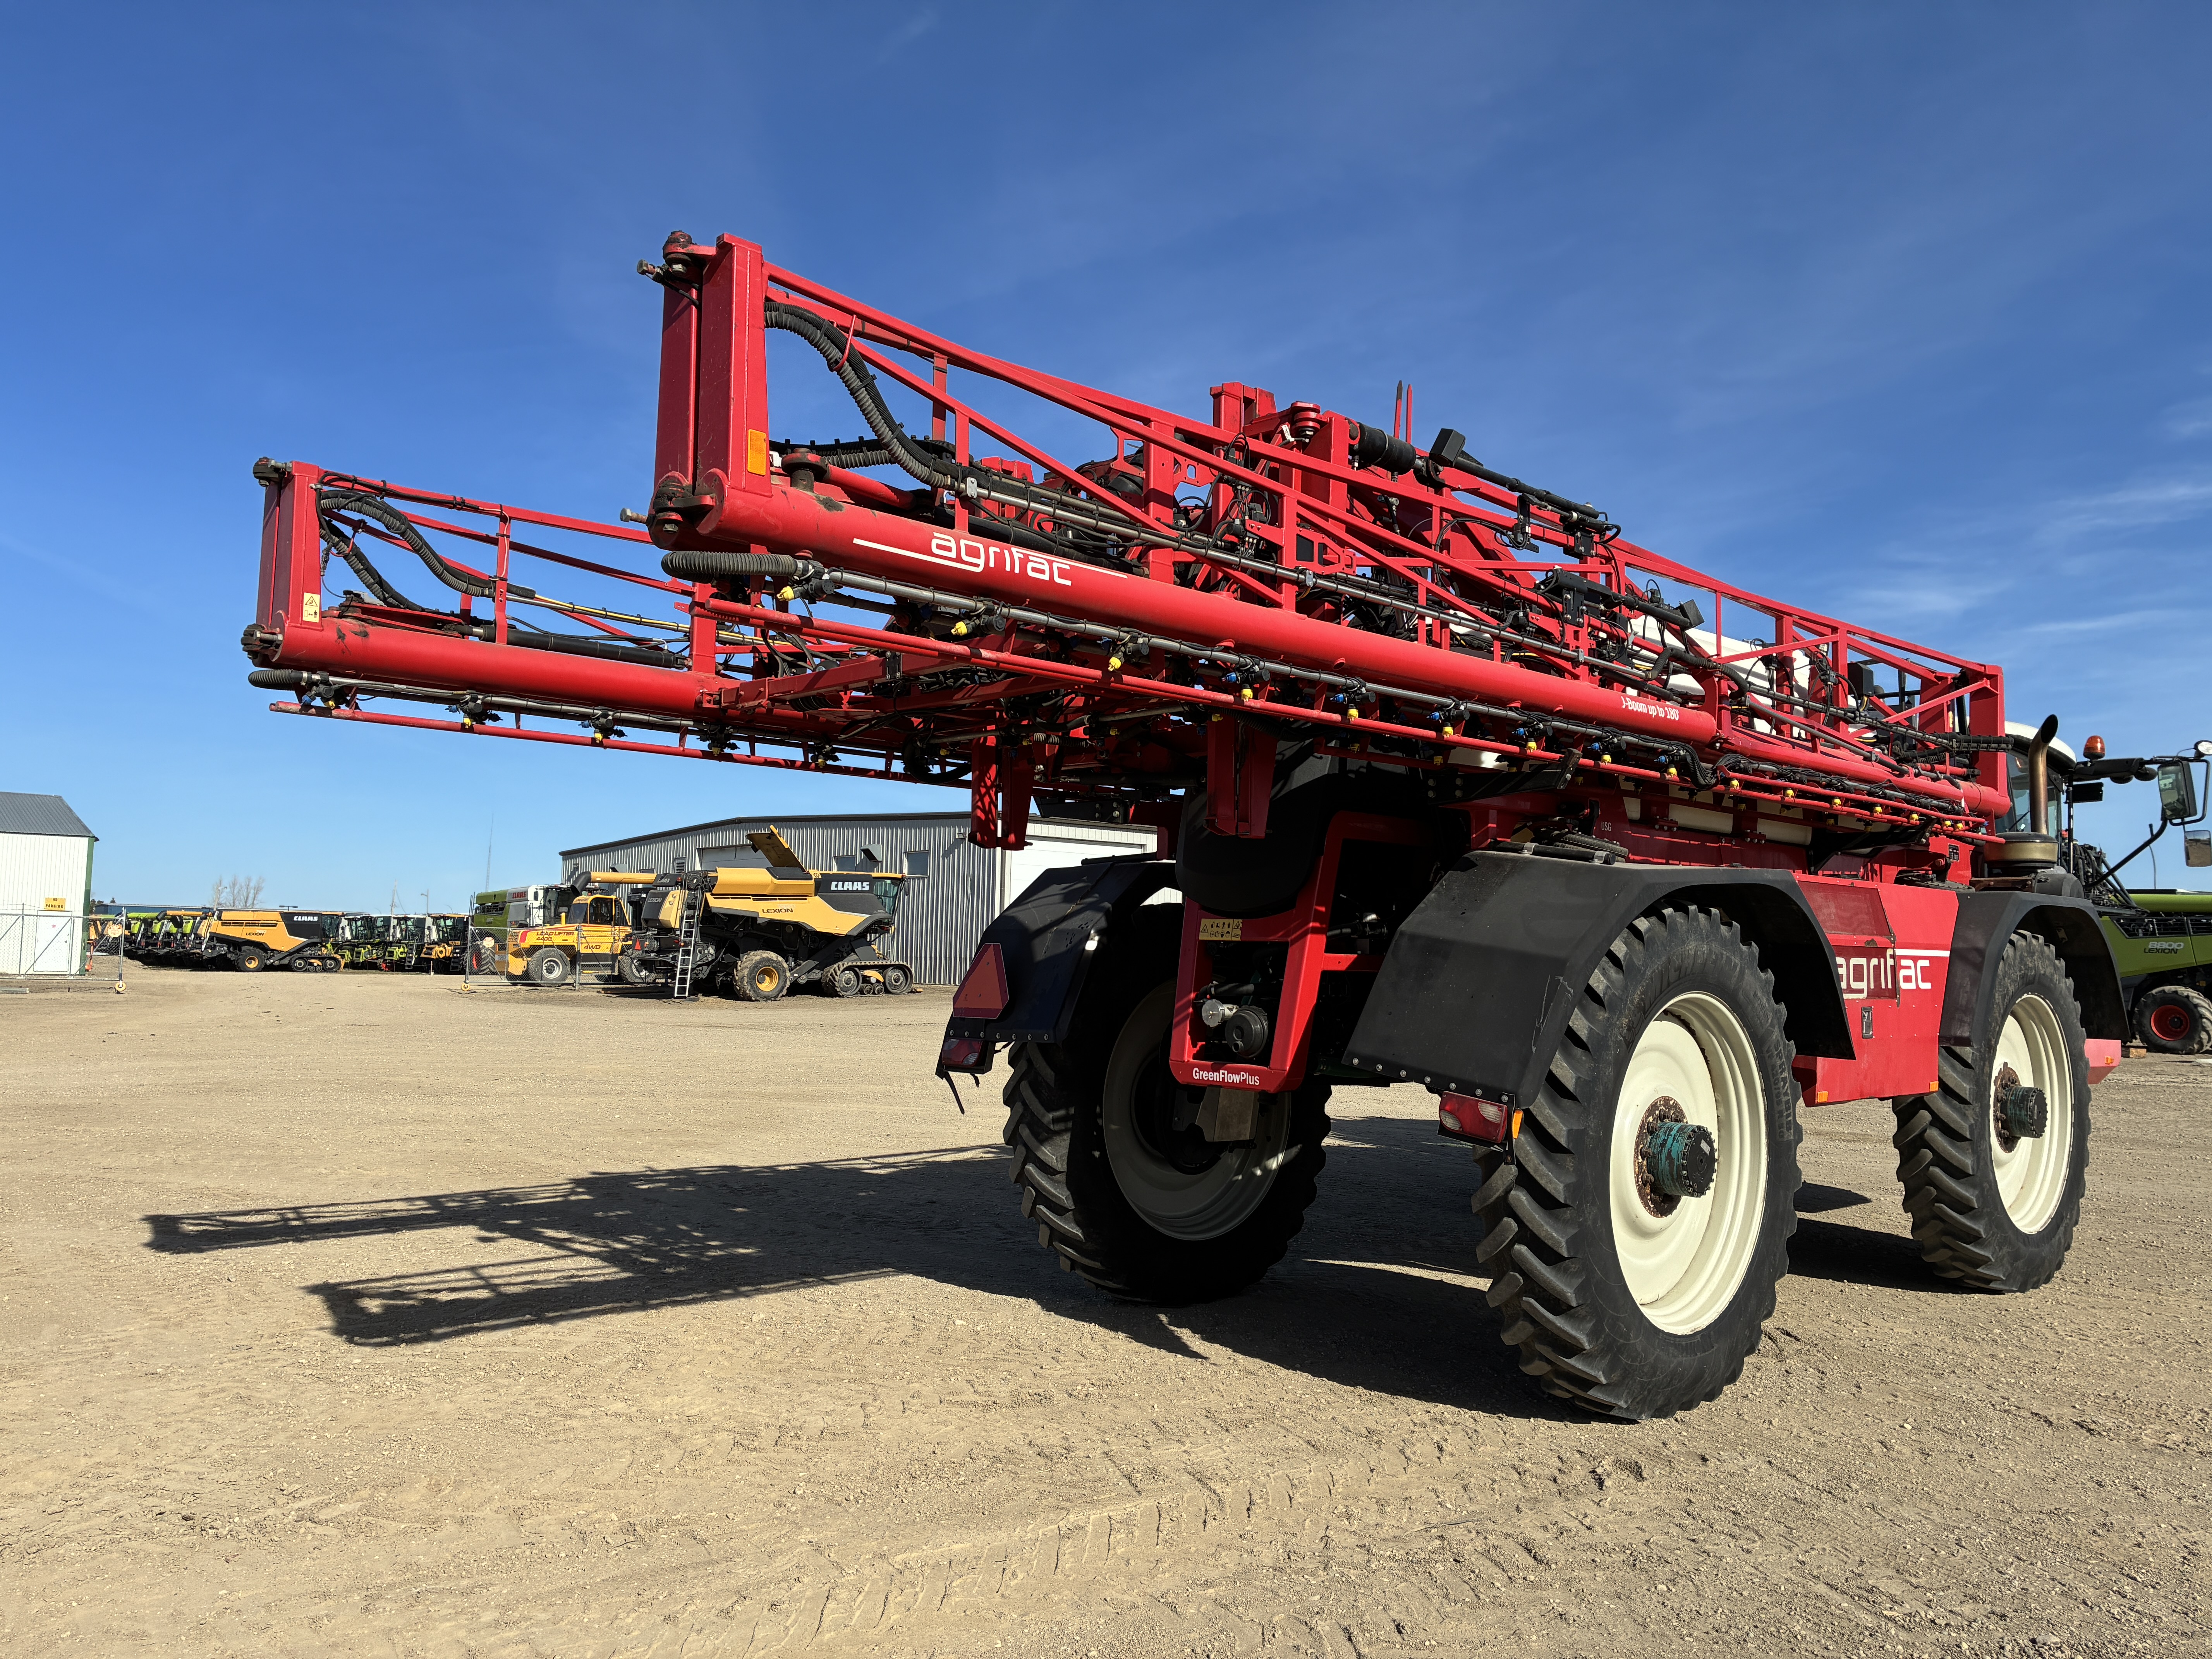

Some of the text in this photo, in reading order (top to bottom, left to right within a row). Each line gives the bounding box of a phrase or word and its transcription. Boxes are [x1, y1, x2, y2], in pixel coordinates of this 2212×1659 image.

[931, 532, 1072, 586] agrifac
[1621, 696, 1647, 713] J-Boom
[1647, 704, 1657, 718] up
[1656, 705, 1665, 717] to
[1601, 821, 1611, 831] USG
[831, 881, 870, 891] CLAAS
[1193, 1067, 1260, 1085] GreenFlowPlus
